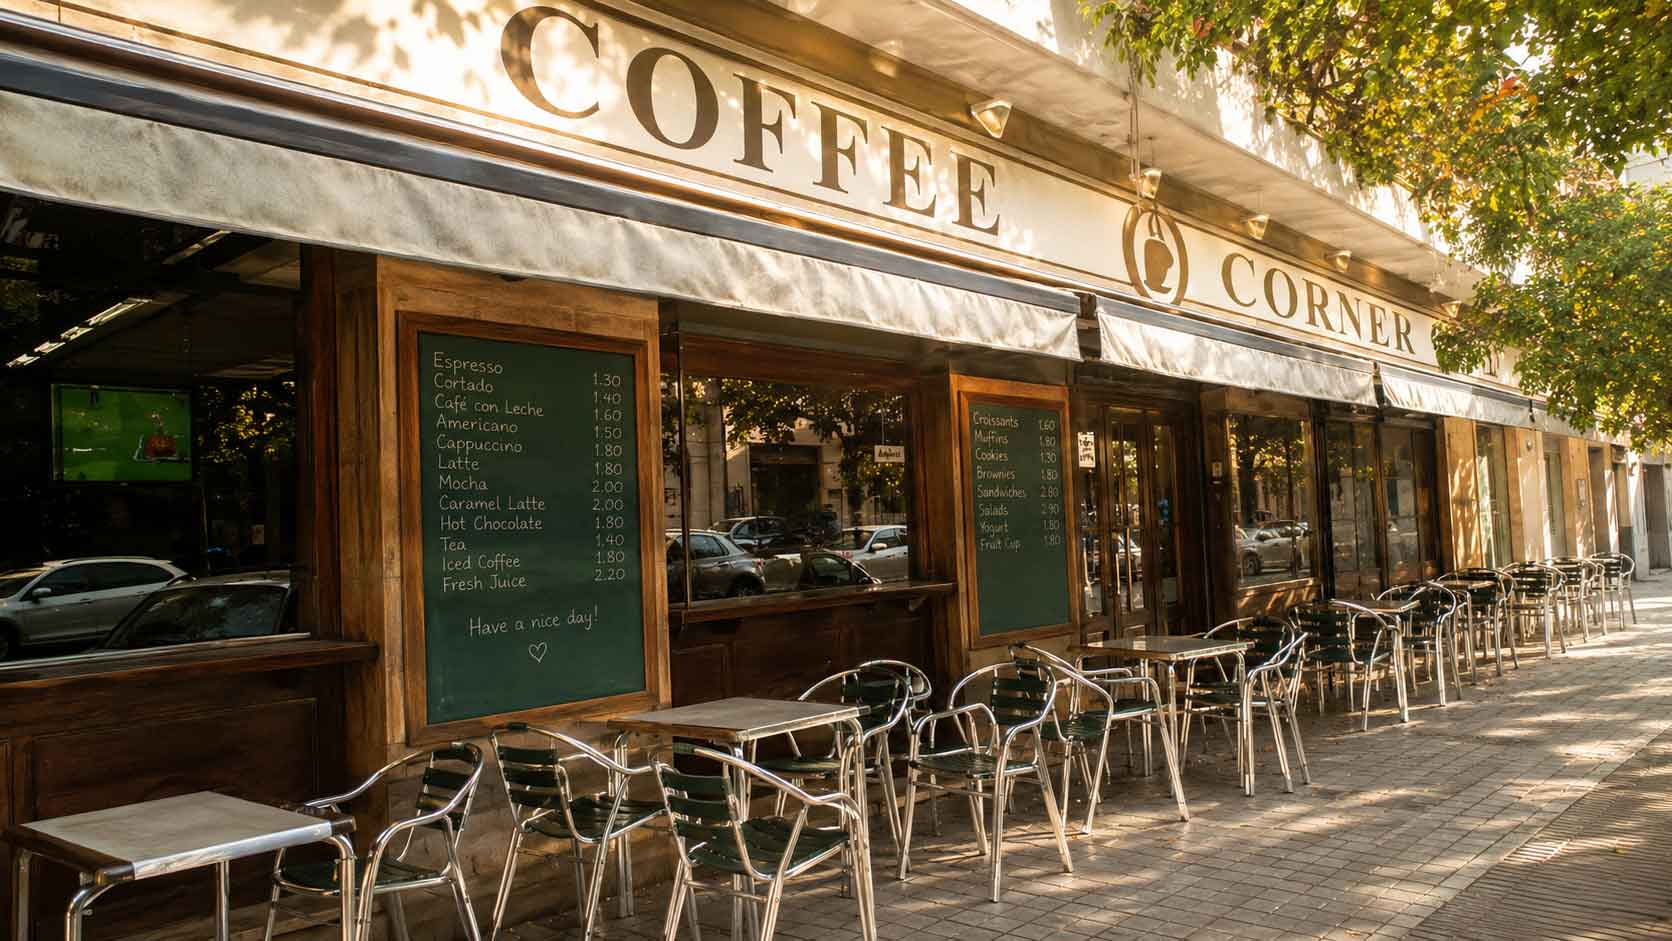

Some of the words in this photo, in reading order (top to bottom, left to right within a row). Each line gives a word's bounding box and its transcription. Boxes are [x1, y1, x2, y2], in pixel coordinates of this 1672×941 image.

[500, 5, 1001, 236] COFFEE
[1221, 252, 1417, 355] CORNER
[433, 351, 504, 375] Espresso
[594, 372, 621, 387] 1.30
[433, 373, 494, 393] Cortado
[594, 391, 622, 404] 1.40
[434, 394, 467, 414] Café
[474, 402, 499, 413] con
[505, 400, 544, 417] Leche
[595, 408, 622, 421] 1.60
[436, 414, 519, 433] Americano
[595, 425, 622, 439] 1.50
[973, 412, 1019, 429] Croissants
[436, 434, 523, 455] Cappuccino
[595, 443, 623, 457] 1.80
[975, 430, 1008, 448] Muffins
[438, 454, 480, 471] Latte
[595, 461, 623, 475] 1.80
[975, 448, 1008, 462] Cookies
[976, 465, 1016, 480] Brownies
[439, 475, 489, 490] Mocha
[592, 479, 624, 494] 2.00
[439, 494, 501, 511] Caramel
[508, 496, 545, 510] Latte
[592, 498, 624, 511] 2.00
[978, 503, 1009, 517] Salads
[440, 515, 466, 531] Hot
[473, 515, 543, 530] Chocolate
[595, 515, 624, 529] 1.80
[979, 520, 1009, 537] Yogurt
[440, 536, 466, 552] Tea
[596, 533, 625, 547] 1.40
[980, 537, 1002, 551] Fruit
[442, 554, 472, 571] Iced
[478, 553, 521, 571] Coffee
[596, 551, 625, 564] 1.80
[443, 576, 483, 592] Fresh
[489, 574, 528, 589] Juice
[594, 568, 625, 581] 2.20
[469, 616, 508, 637] Have
[514, 620, 525, 631] a
[530, 614, 561, 630] nice
[567, 604, 599, 631] day!
